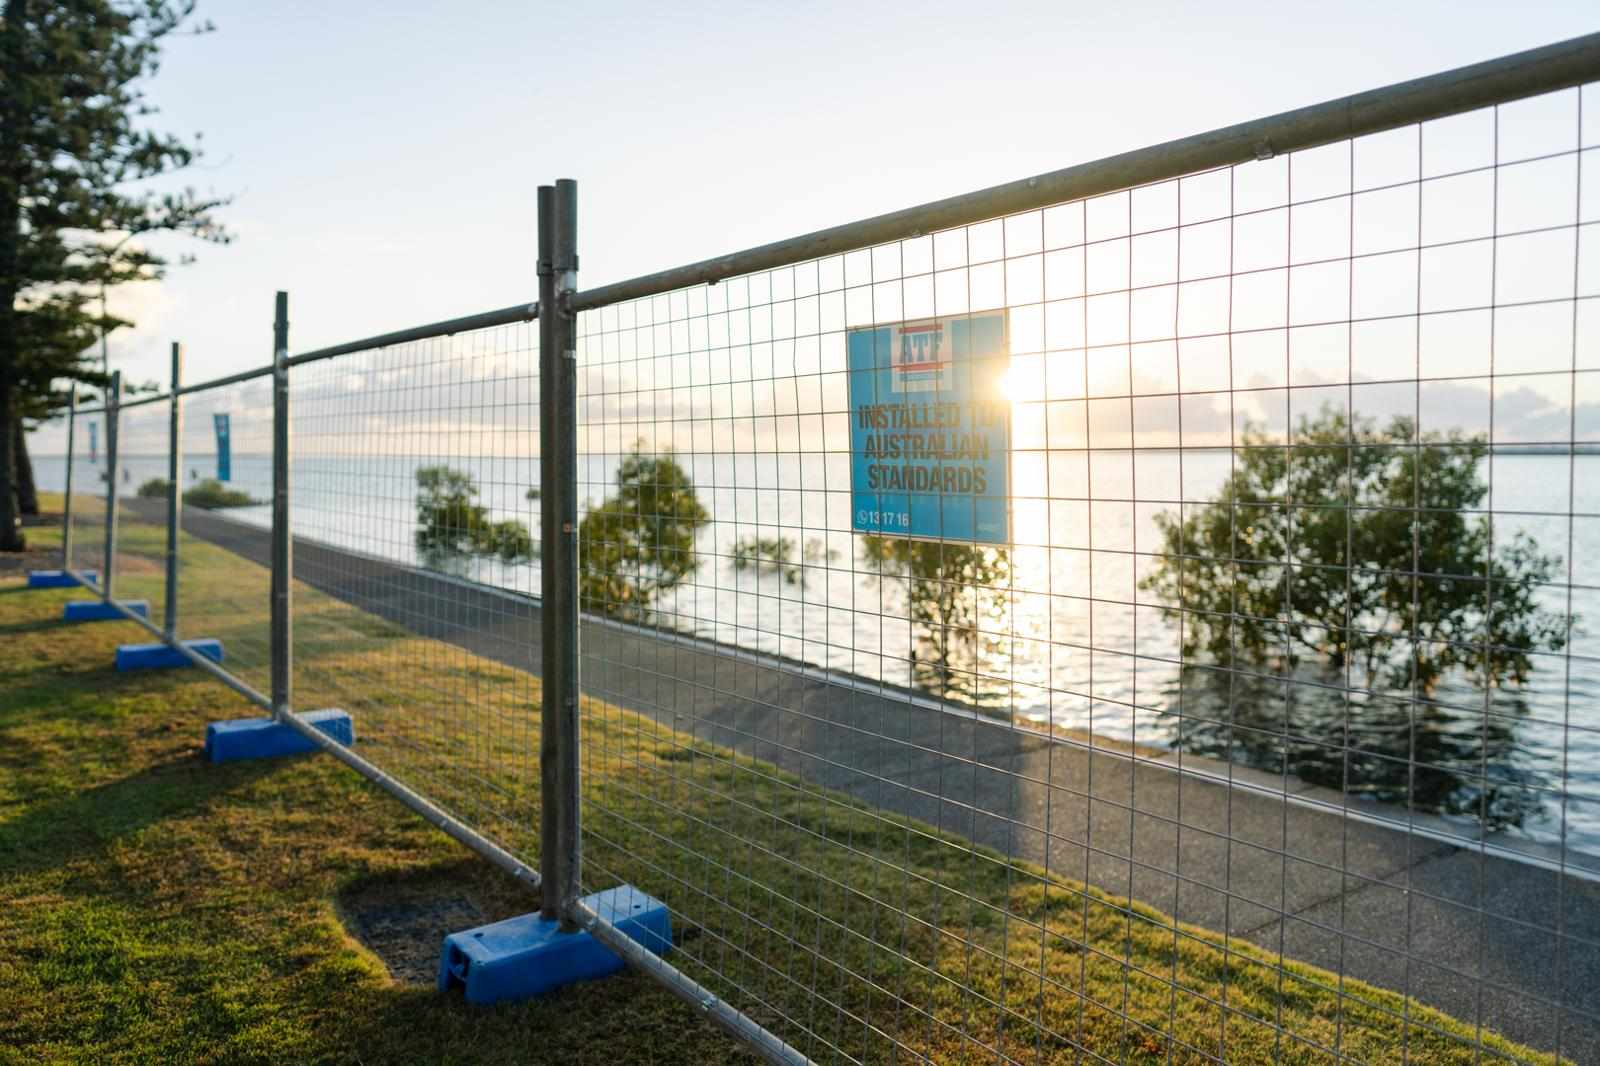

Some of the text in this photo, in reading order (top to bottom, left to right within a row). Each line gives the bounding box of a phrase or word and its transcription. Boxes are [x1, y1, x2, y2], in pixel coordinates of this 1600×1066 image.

[898, 332, 944, 364] ATF
[859, 400, 998, 430] INSTALLED TO
[864, 432, 989, 461] AUSTRALIAN
[867, 464, 987, 495] STANDARDS
[869, 512, 909, 526] 13 17 16
